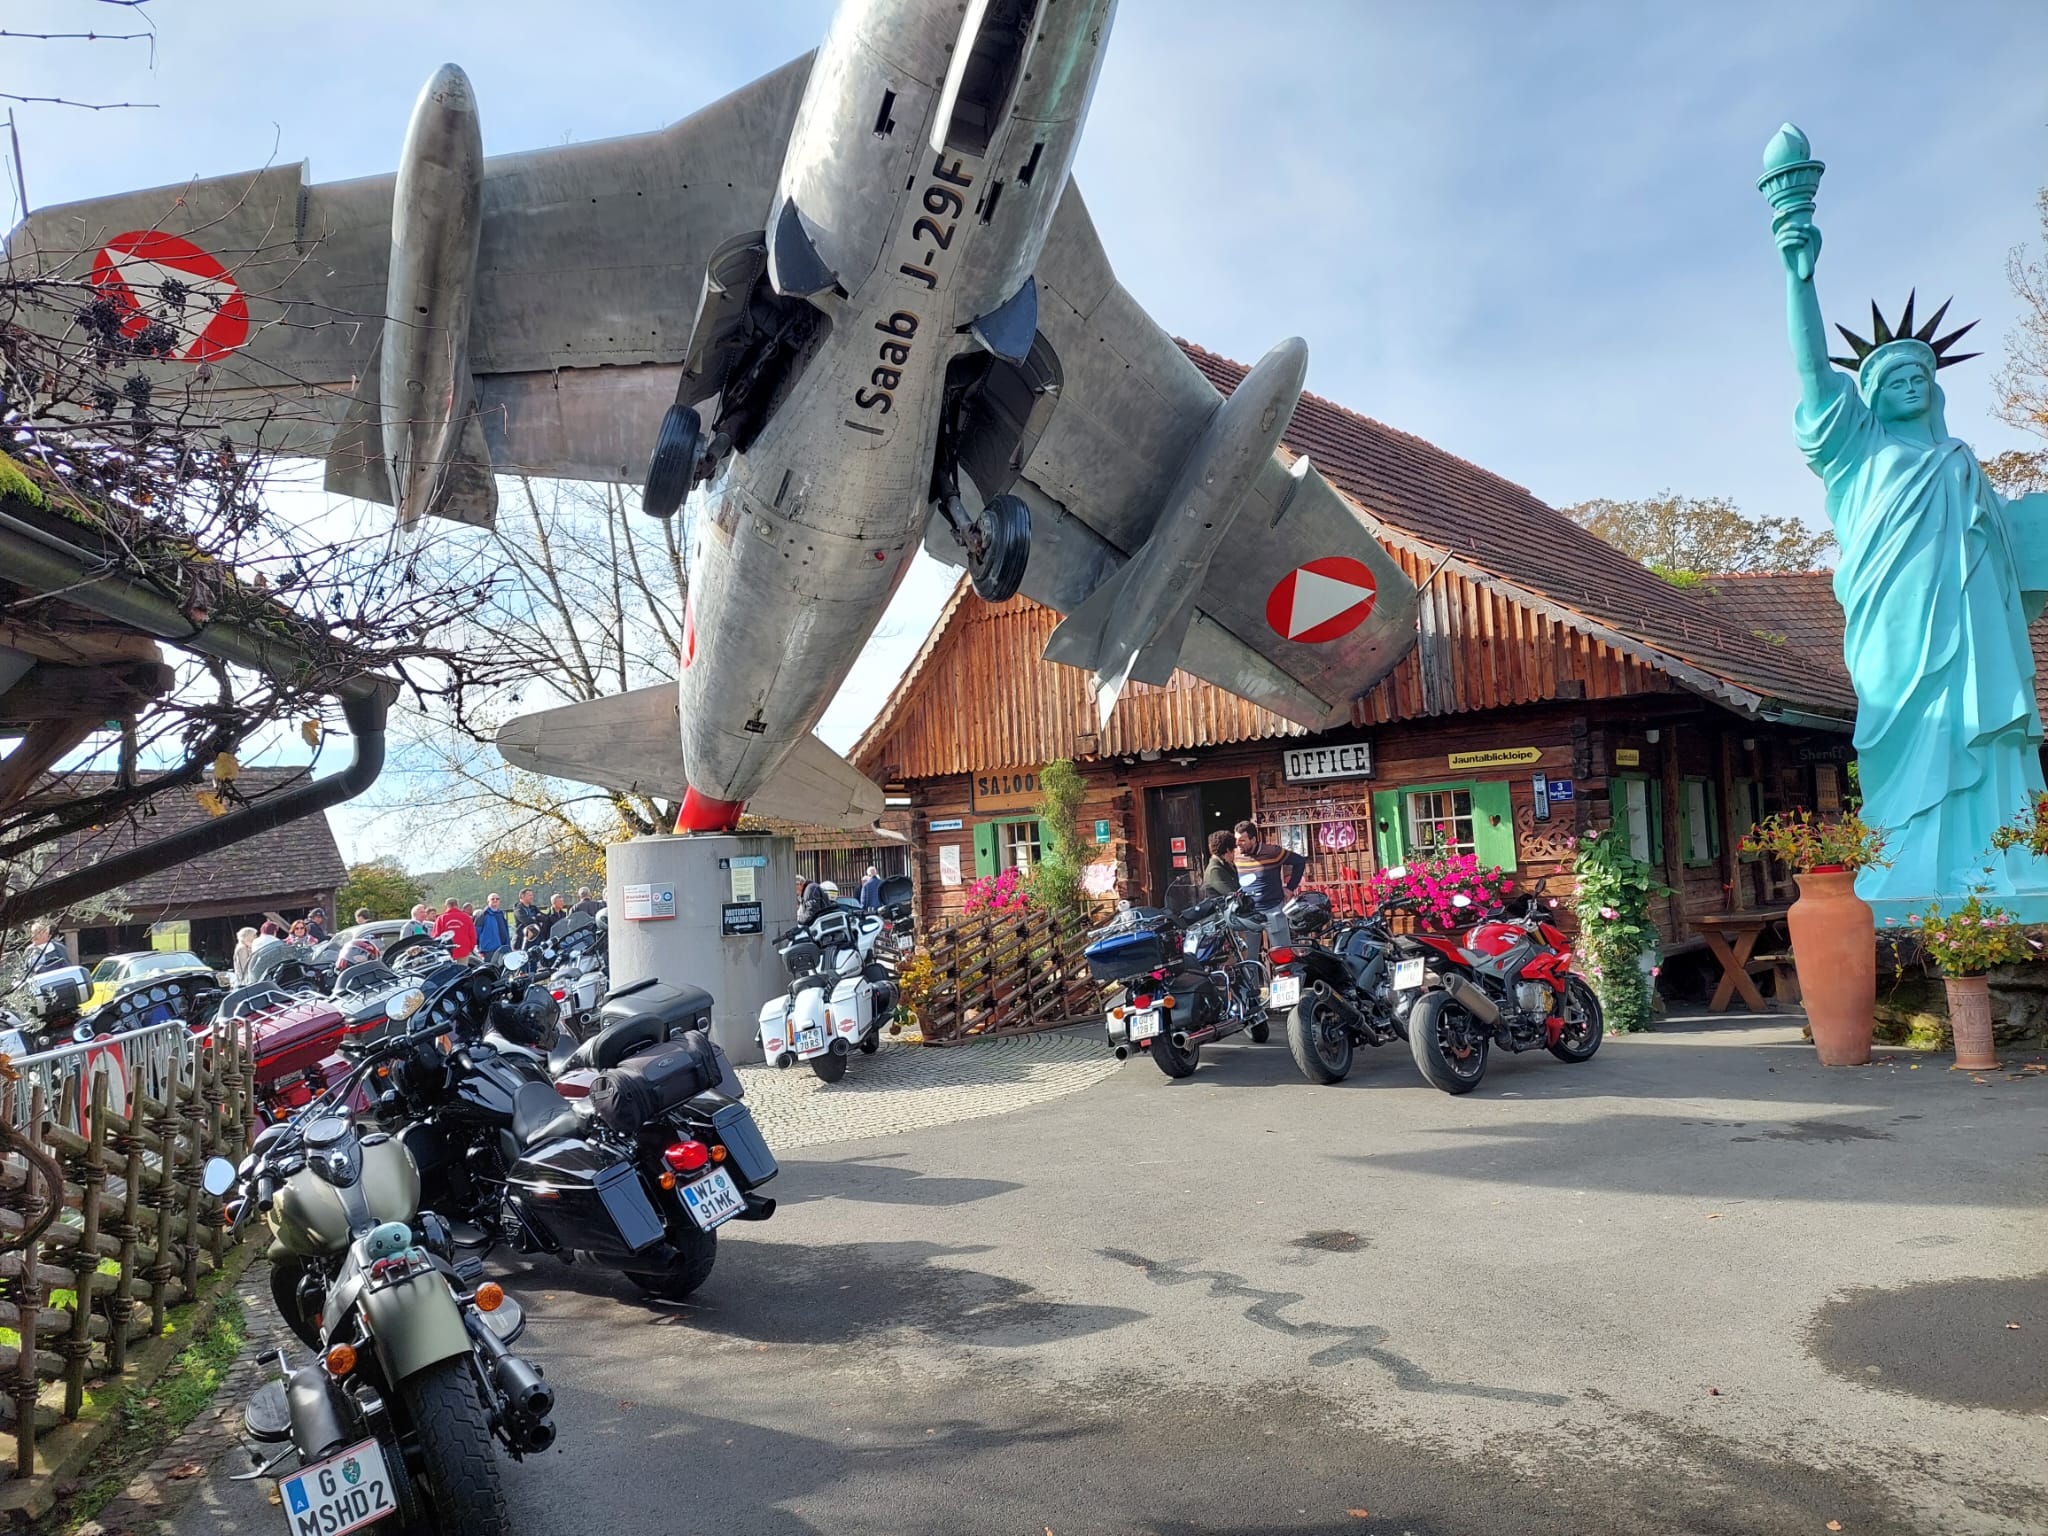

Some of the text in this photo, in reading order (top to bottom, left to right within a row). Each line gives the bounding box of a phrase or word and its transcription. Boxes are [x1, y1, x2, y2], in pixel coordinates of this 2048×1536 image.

[899, 152, 974, 290] J-29F
[854, 308, 920, 415] Saab
[1452, 751, 1533, 765] Jauntalblickloipe
[1799, 745, 1845, 760] Sheriff
[1290, 746, 1366, 777] OFFICE
[1557, 782, 1564, 791] 3
[724, 914, 760, 924] PARKING ONLY
[725, 907, 760, 917] MOTORCYCLE
[801, 1030, 812, 1041] WZ
[693, 1179, 717, 1200] WZ
[318, 1468, 337, 1497] G
[296, 1500, 305, 1510] A
